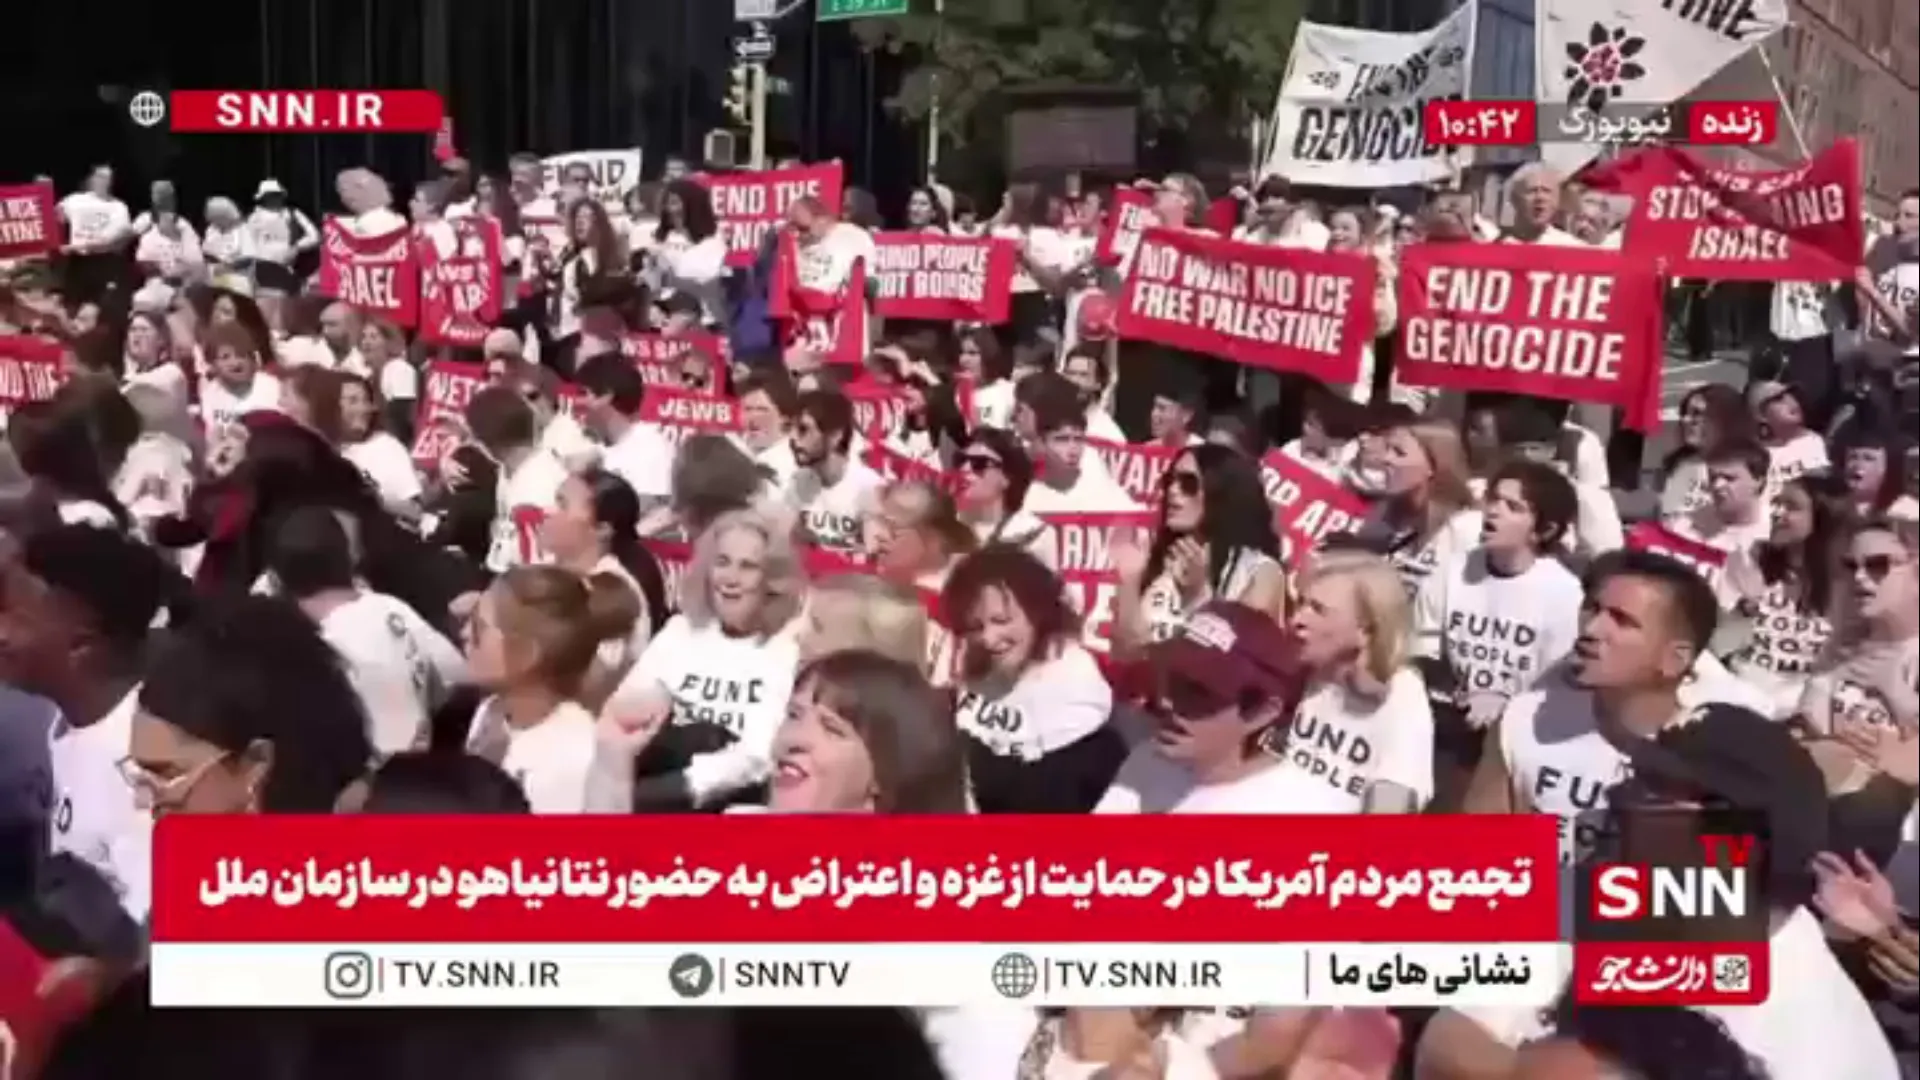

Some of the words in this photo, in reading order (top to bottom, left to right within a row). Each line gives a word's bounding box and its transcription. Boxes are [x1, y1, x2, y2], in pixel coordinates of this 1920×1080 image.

[1293, 95, 1460, 161] GENOCI
[711, 184, 767, 216] END
[924, 244, 990, 274] PEOPLE
[1138, 242, 1179, 281] NO
[1183, 253, 1249, 297] WAR
[1254, 264, 1297, 306] NO
[1302, 273, 1354, 315] ICE
[913, 271, 986, 302] BOMBS
[1426, 265, 1512, 315] END
[1526, 270, 1616, 323] THE
[1130, 281, 1195, 326] FREE
[1197, 295, 1345, 356] PALESTINE
[1405, 316, 1626, 381] GENOCIDE
[1450, 611, 1537, 648] FUND
[1293, 712, 1371, 765] UND
[1292, 749, 1367, 796] OPLE
